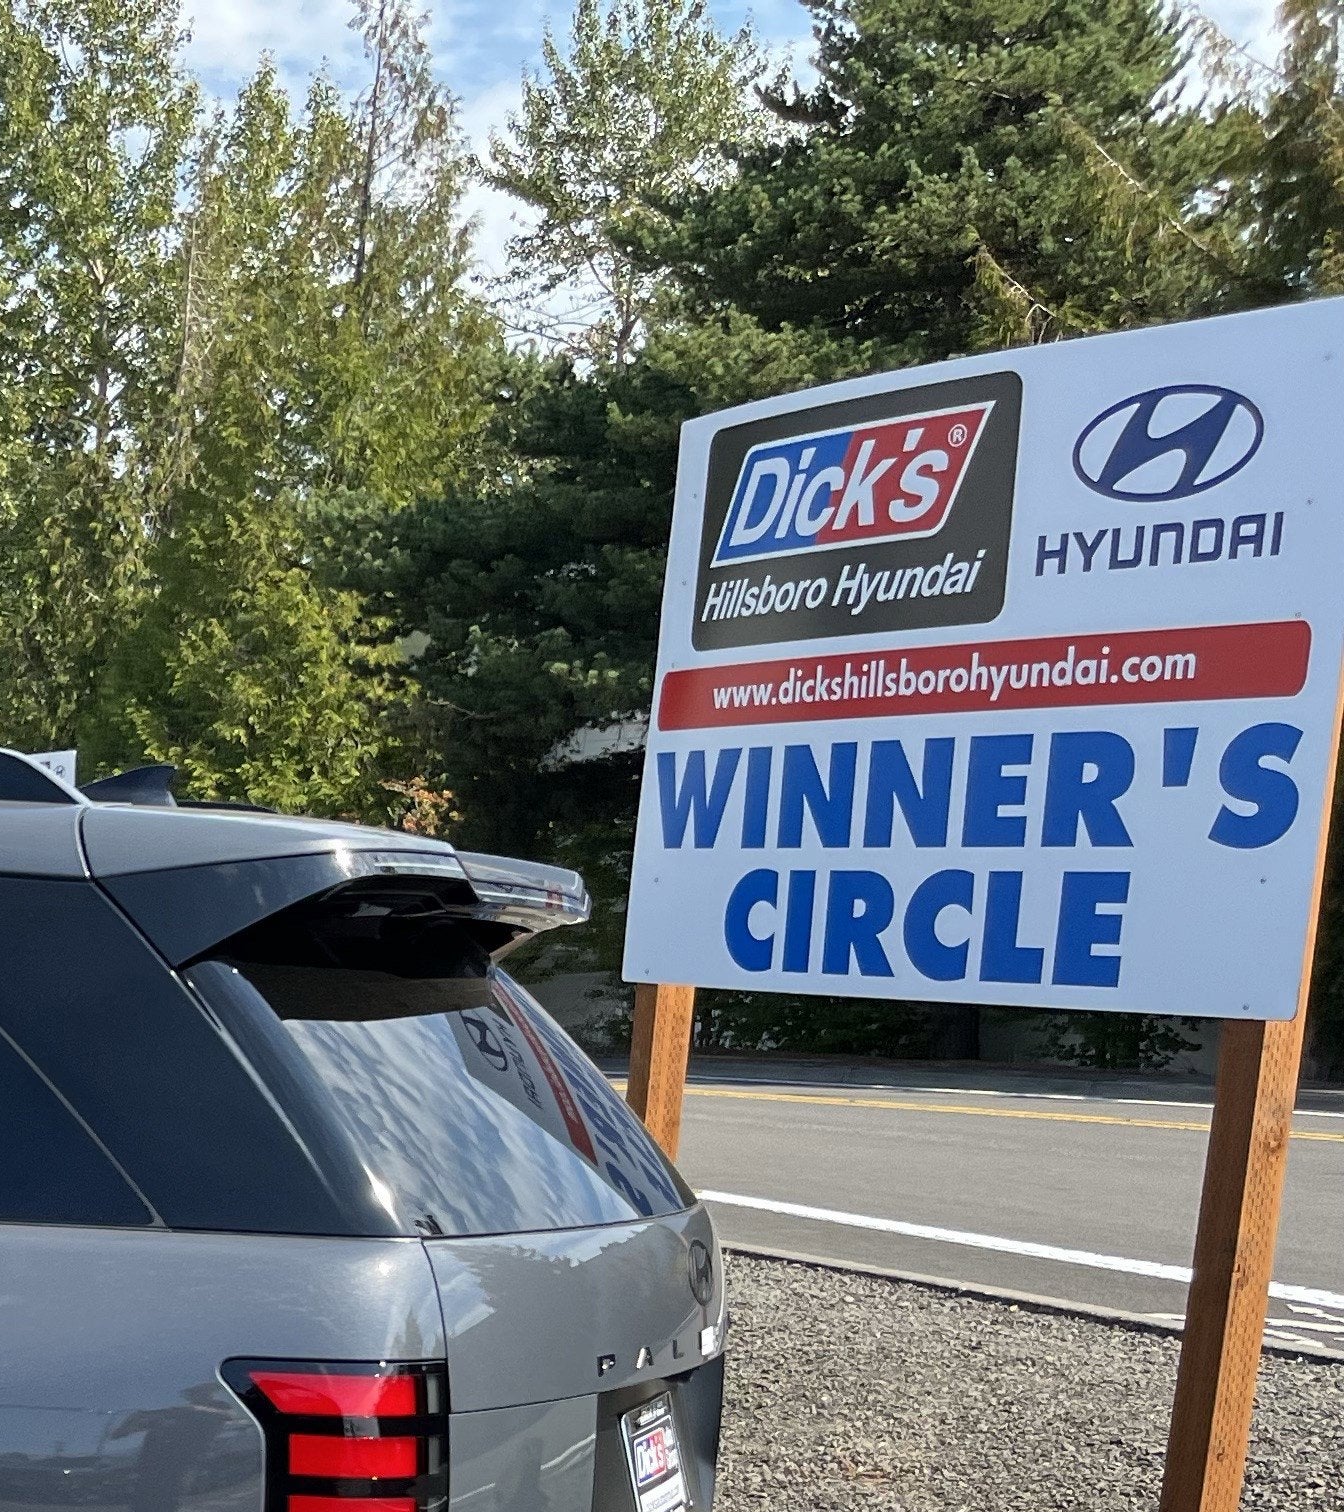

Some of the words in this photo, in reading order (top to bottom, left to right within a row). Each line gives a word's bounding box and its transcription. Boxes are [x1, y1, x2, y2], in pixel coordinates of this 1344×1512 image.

[729, 427, 949, 547] Dick's
[701, 575, 828, 623] Hillsboro
[831, 549, 987, 616] Hyundai
[1035, 511, 1284, 577] HYUNDAI
[712, 647, 1196, 712] www.dickshillsborohyundai.com
[656, 722, 1304, 850] WINNER'S
[723, 868, 1132, 988] CIRCLE
